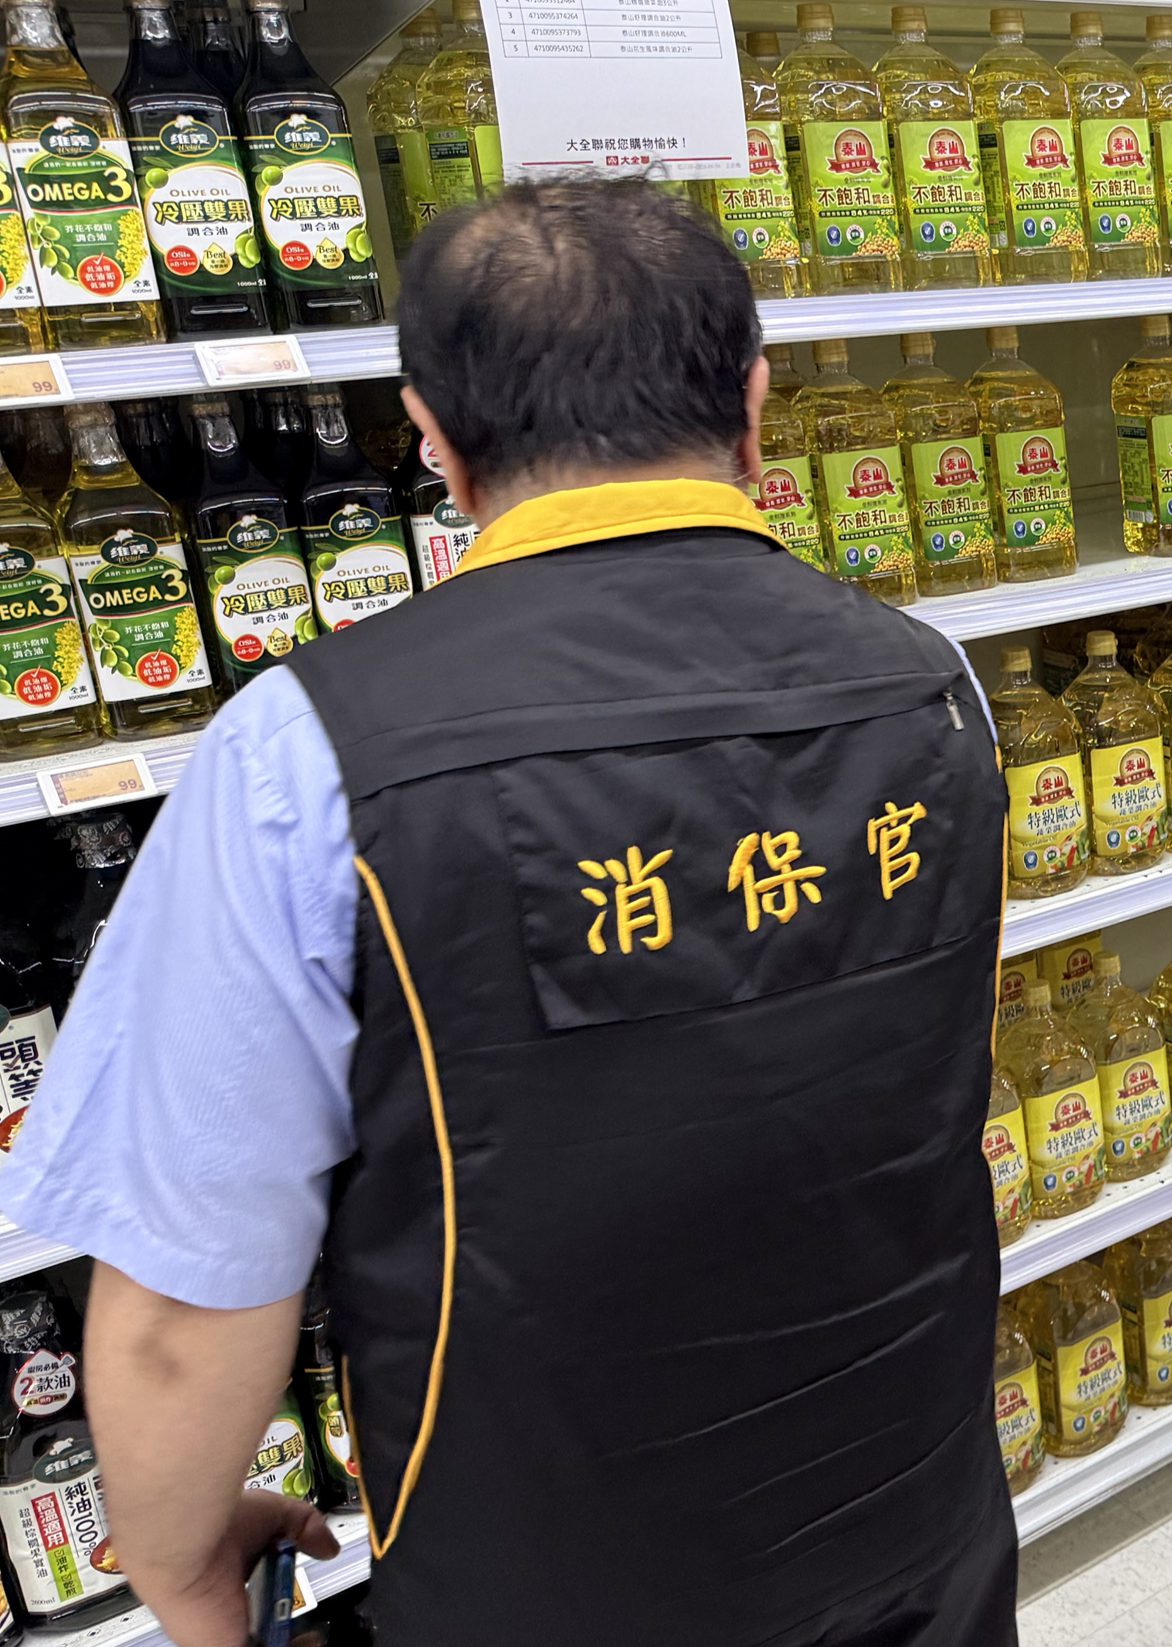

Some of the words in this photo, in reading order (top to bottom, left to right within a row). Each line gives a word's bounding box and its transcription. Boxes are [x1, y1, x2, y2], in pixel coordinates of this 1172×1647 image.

[841, 142, 866, 157] 泰山
[935, 140, 959, 155] 泰山
[1036, 139, 1058, 152] 泰山
[1113, 138, 1134, 151] 泰山
[620, 155, 650, 166] 大全聯
[170, 189, 207, 197] OLIVE
[210, 188, 231, 196] OIL
[284, 185, 318, 194] OLIVE
[322, 184, 342, 192] OIL
[153, 200, 250, 224] 冷壓雙果
[269, 196, 363, 220] 冷壓雙果
[187, 226, 228, 236] 調合油
[300, 222, 340, 232] 調合油
[75, 233, 107, 242] 調合油
[274, 360, 291, 370] 99
[32, 381, 53, 393] 99
[1027, 446, 1049, 460] 泰山
[944, 457, 967, 471] 泰山
[859, 467, 883, 482] 泰山
[766, 479, 791, 494] 泰山
[337, 568, 370, 578] OLIVE
[373, 564, 391, 572] OIL
[237, 581, 269, 591] OLIVE
[272, 577, 290, 586] OIL
[322, 572, 410, 601] 冷壓雙果
[222, 585, 310, 617] 冷壓雙果
[352, 599, 389, 611] 調合油
[252, 612, 289, 625] 調合油
[134, 632, 164, 642] 調合油
[13, 648, 44, 659] 調合油
[1125, 757, 1145, 772] 泰山
[118, 779, 137, 791] 99
[1042, 775, 1064, 791] 泰山
[1112, 783, 1162, 809] 特級歐式
[1028, 800, 1081, 829] 特級歐式
[577, 801, 928, 955] 消保官
[1128, 1068, 1149, 1084] 泰山
[1061, 1101, 1081, 1116] 泰山
[1115, 1090, 1165, 1120] 特級歐式
[983, 1133, 1004, 1149] 泰山
[1046, 1122, 1099, 1154] 特級歐式
[35, 1496, 64, 1548] 高溫適用
